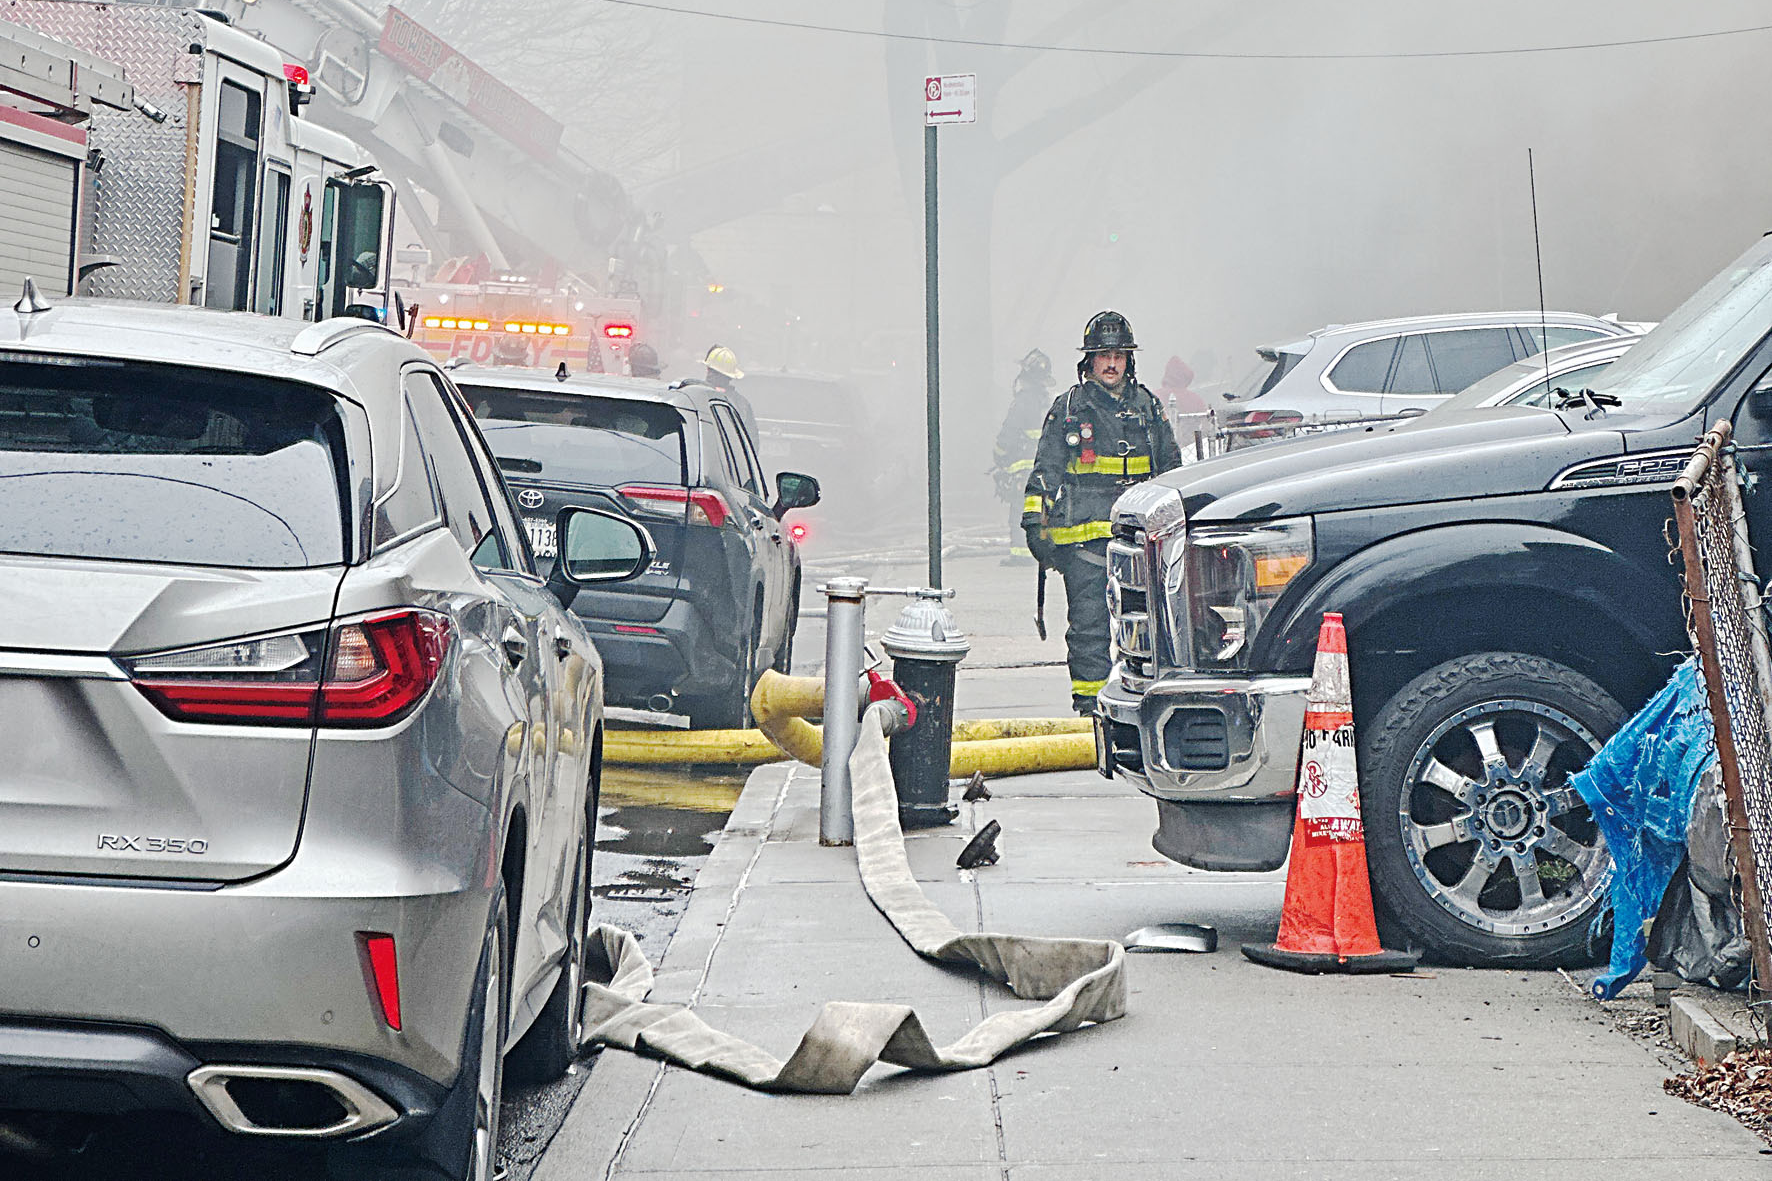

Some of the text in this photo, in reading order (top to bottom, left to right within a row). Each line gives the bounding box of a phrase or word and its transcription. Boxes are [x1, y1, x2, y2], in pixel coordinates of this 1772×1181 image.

[388, 12, 443, 69] TOWER
[451, 334, 551, 366] FDY
[1331, 818, 1361, 831] AWAY
[97, 834, 208, 854] RX 350
